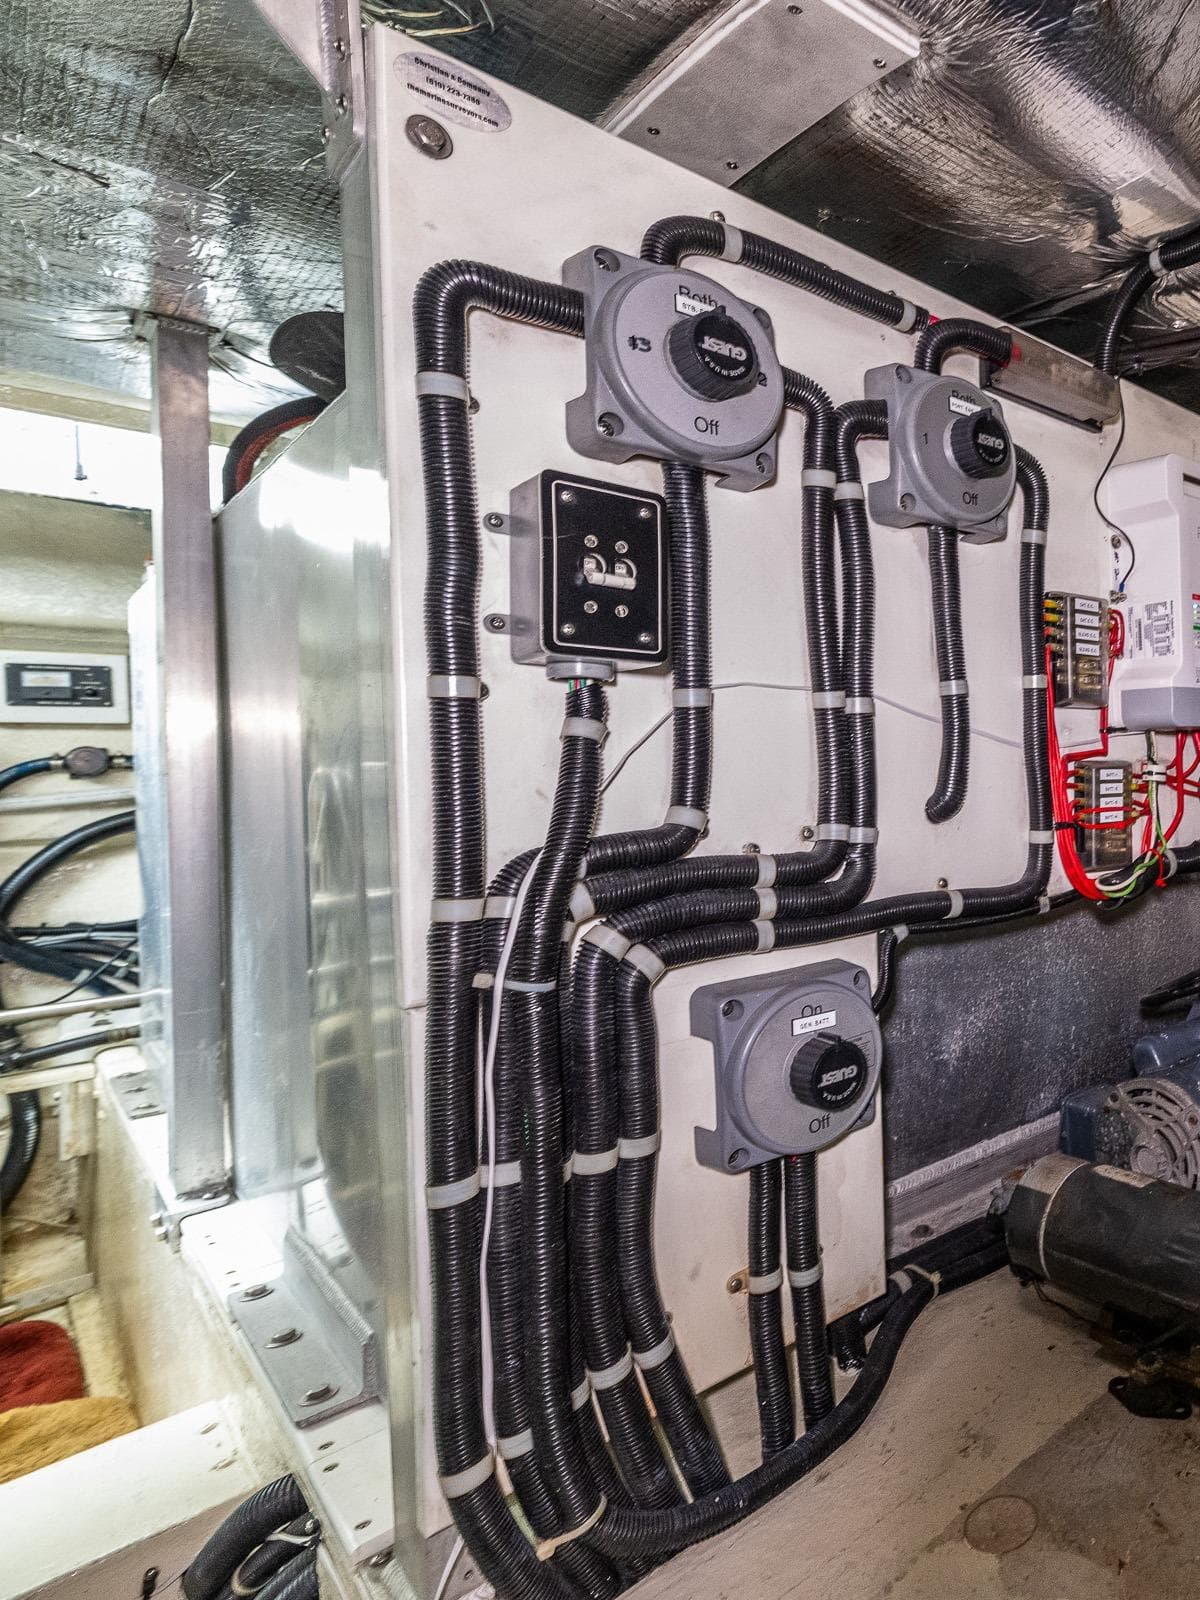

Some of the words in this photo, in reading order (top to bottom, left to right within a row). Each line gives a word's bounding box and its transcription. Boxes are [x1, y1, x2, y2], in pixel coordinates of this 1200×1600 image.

[414, 57, 449, 78] Christian
[457, 76, 491, 97] Company
[694, 416, 720, 436] Off
[922, 432, 928, 445] 1
[962, 491, 978, 506] Off
[817, 1065, 858, 1088] GUEST
[809, 1113, 830, 1133] Off
